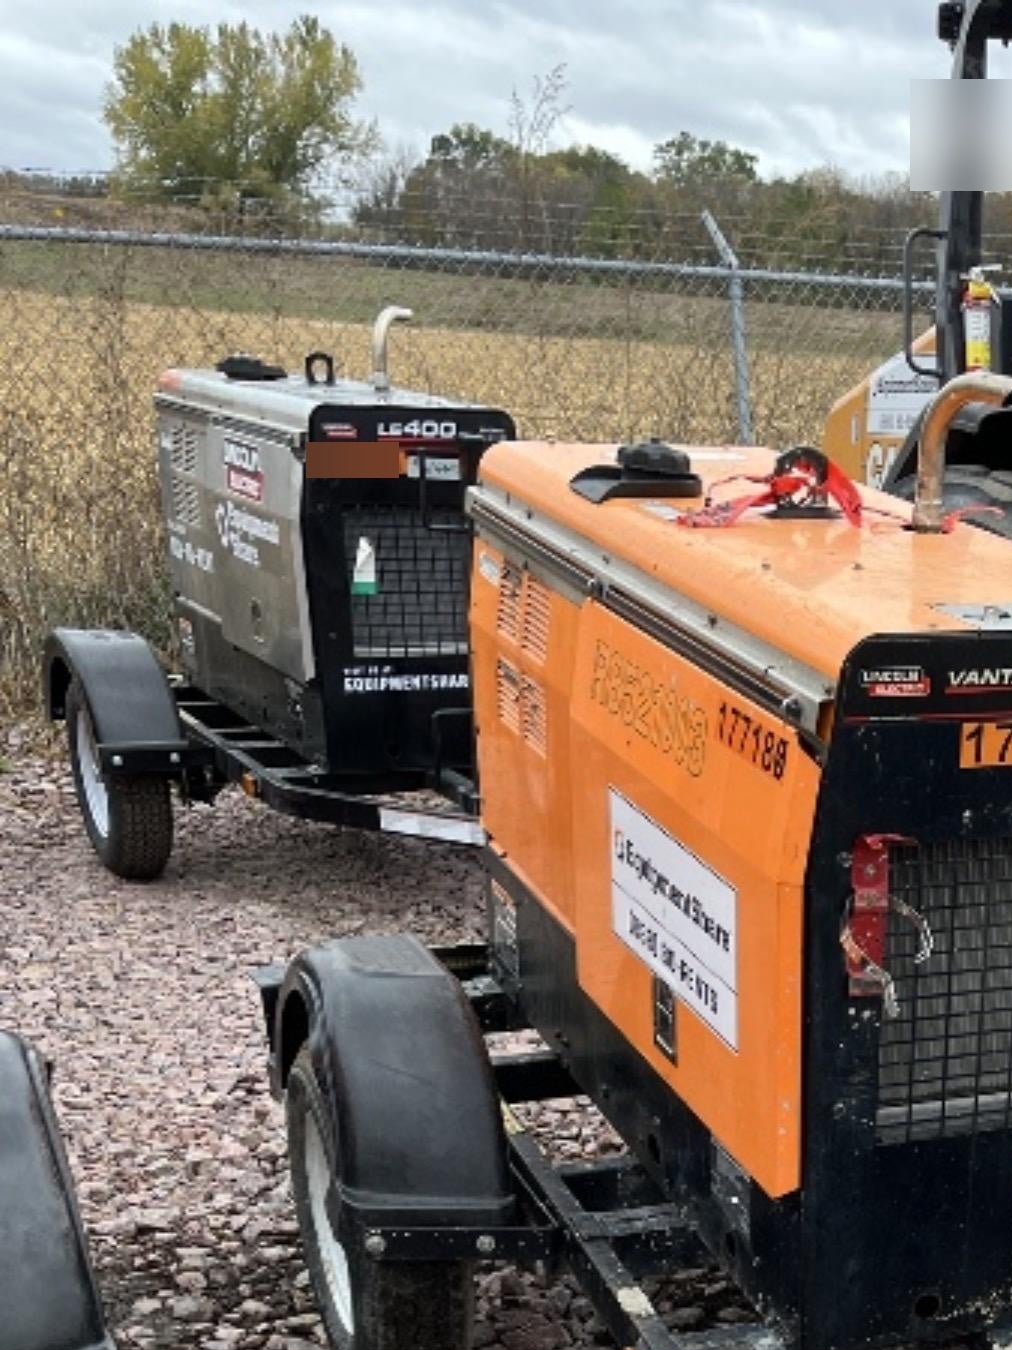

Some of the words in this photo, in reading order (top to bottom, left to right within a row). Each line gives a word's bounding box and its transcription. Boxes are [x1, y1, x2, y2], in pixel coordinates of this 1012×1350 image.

[343, 674, 469, 693] EQUIPMENTSHAR
[862, 670, 919, 683] LINCOLN
[875, 683, 925, 695] ELECTRIC
[717, 700, 790, 782] 177180
[626, 837, 731, 953] EquipmentShare
